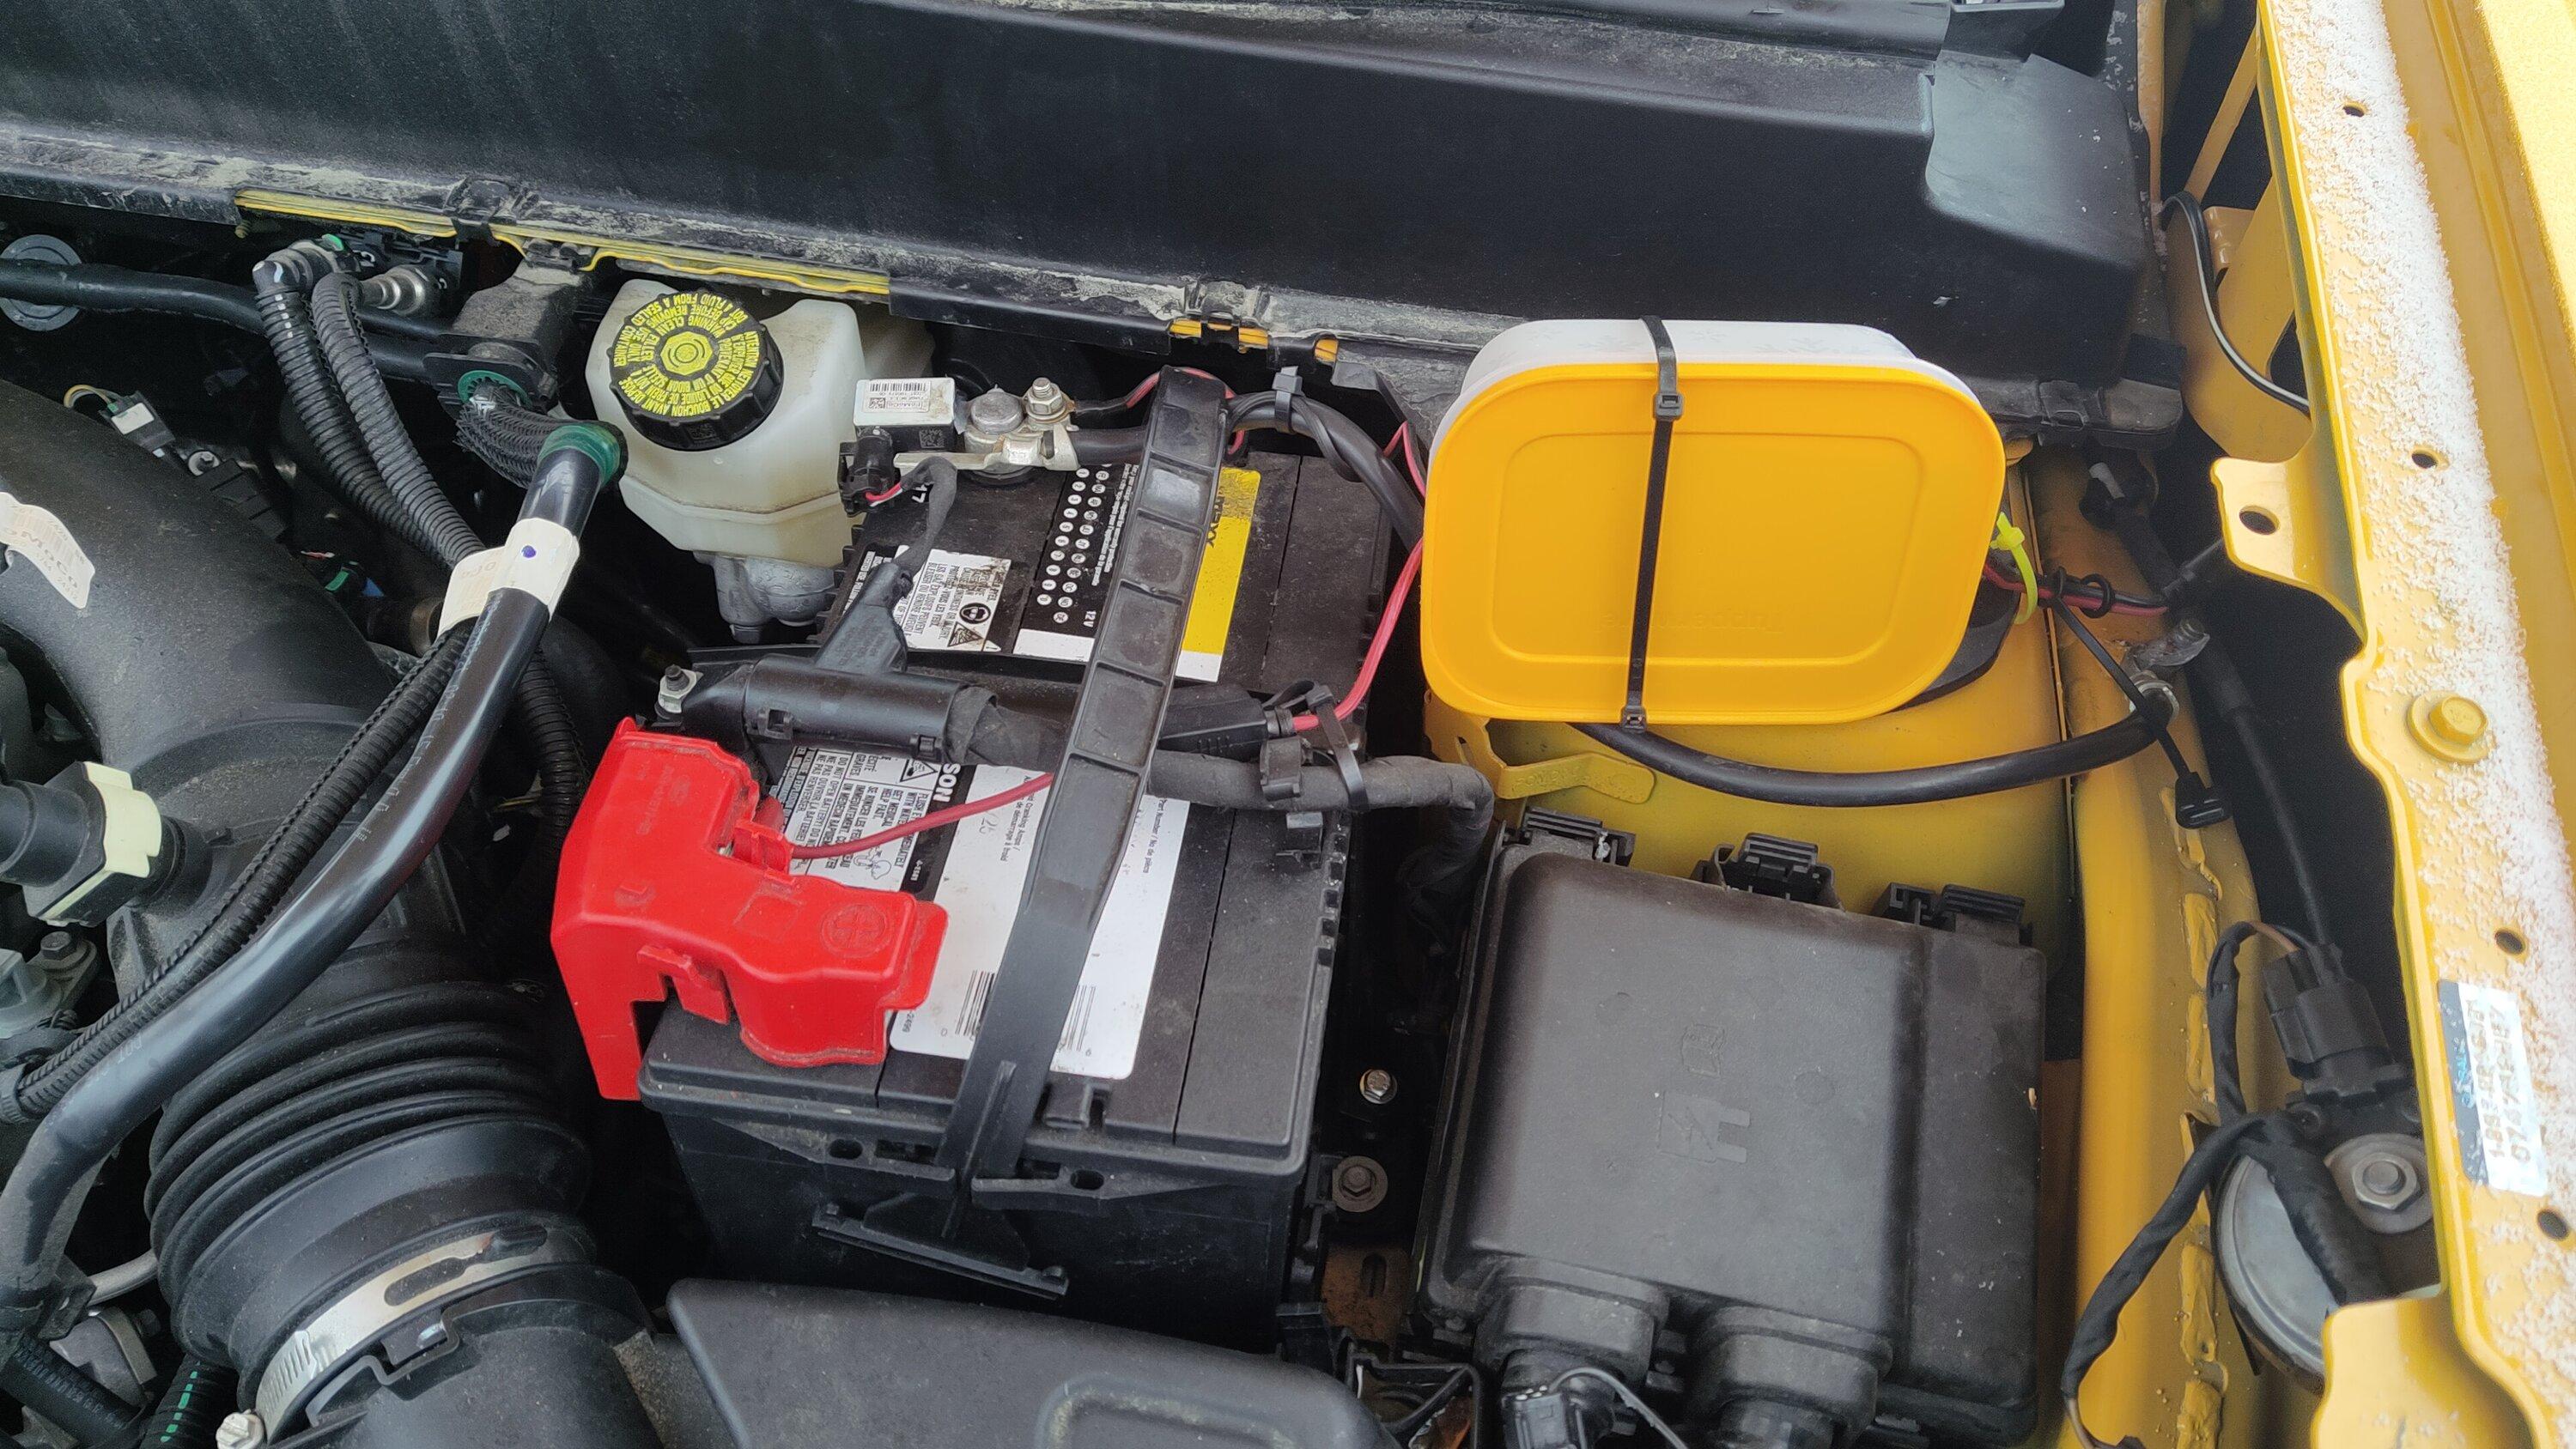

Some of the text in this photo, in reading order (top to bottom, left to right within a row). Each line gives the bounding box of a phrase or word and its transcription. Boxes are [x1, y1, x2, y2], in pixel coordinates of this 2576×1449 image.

[671, 292, 697, 305] FROM
[699, 292, 727, 310] FLUID
[629, 300, 663, 327] SEALED
[642, 304, 686, 329] REMOVING
[690, 302, 723, 321] BEFORE
[728, 306, 749, 324] DOT
[653, 316, 684, 336] CLEAN
[687, 314, 726, 338] WARNING
[718, 313, 738, 330] CAP
[612, 322, 636, 367] CONTAINER
[627, 342, 641, 363] ONLY
[709, 336, 733, 381] PROVENANT
[617, 329, 762, 417] ATTENTION NETTOYER LE BOUCHON AVANT DEPOSE
[632, 374, 651, 390] DOT
[716, 371, 737, 389] QUE
[643, 384, 669, 403] FREIN
[664, 377, 691, 394] BIDON
[708, 382, 724, 396] DU
[666, 391, 679, 404] DE
[679, 388, 712, 403] LIQUIDE
[815, 754, 827, 762] NE
[824, 755, 837, 764] NE
[836, 756, 848, 765] DO
[810, 763, 823, 775] PAS
[820, 764, 834, 776] PAS
[831, 767, 844, 779] NOT
[810, 777, 829, 801] OUVRIR
[824, 779, 839, 797] OPEN
[1017, 802, 1033, 828] Cranking
[1151, 812, 1163, 834] Number
[1012, 829, 1025, 846] Amps
[1148, 839, 1157, 847] No
[999, 846, 1011, 861] froid
